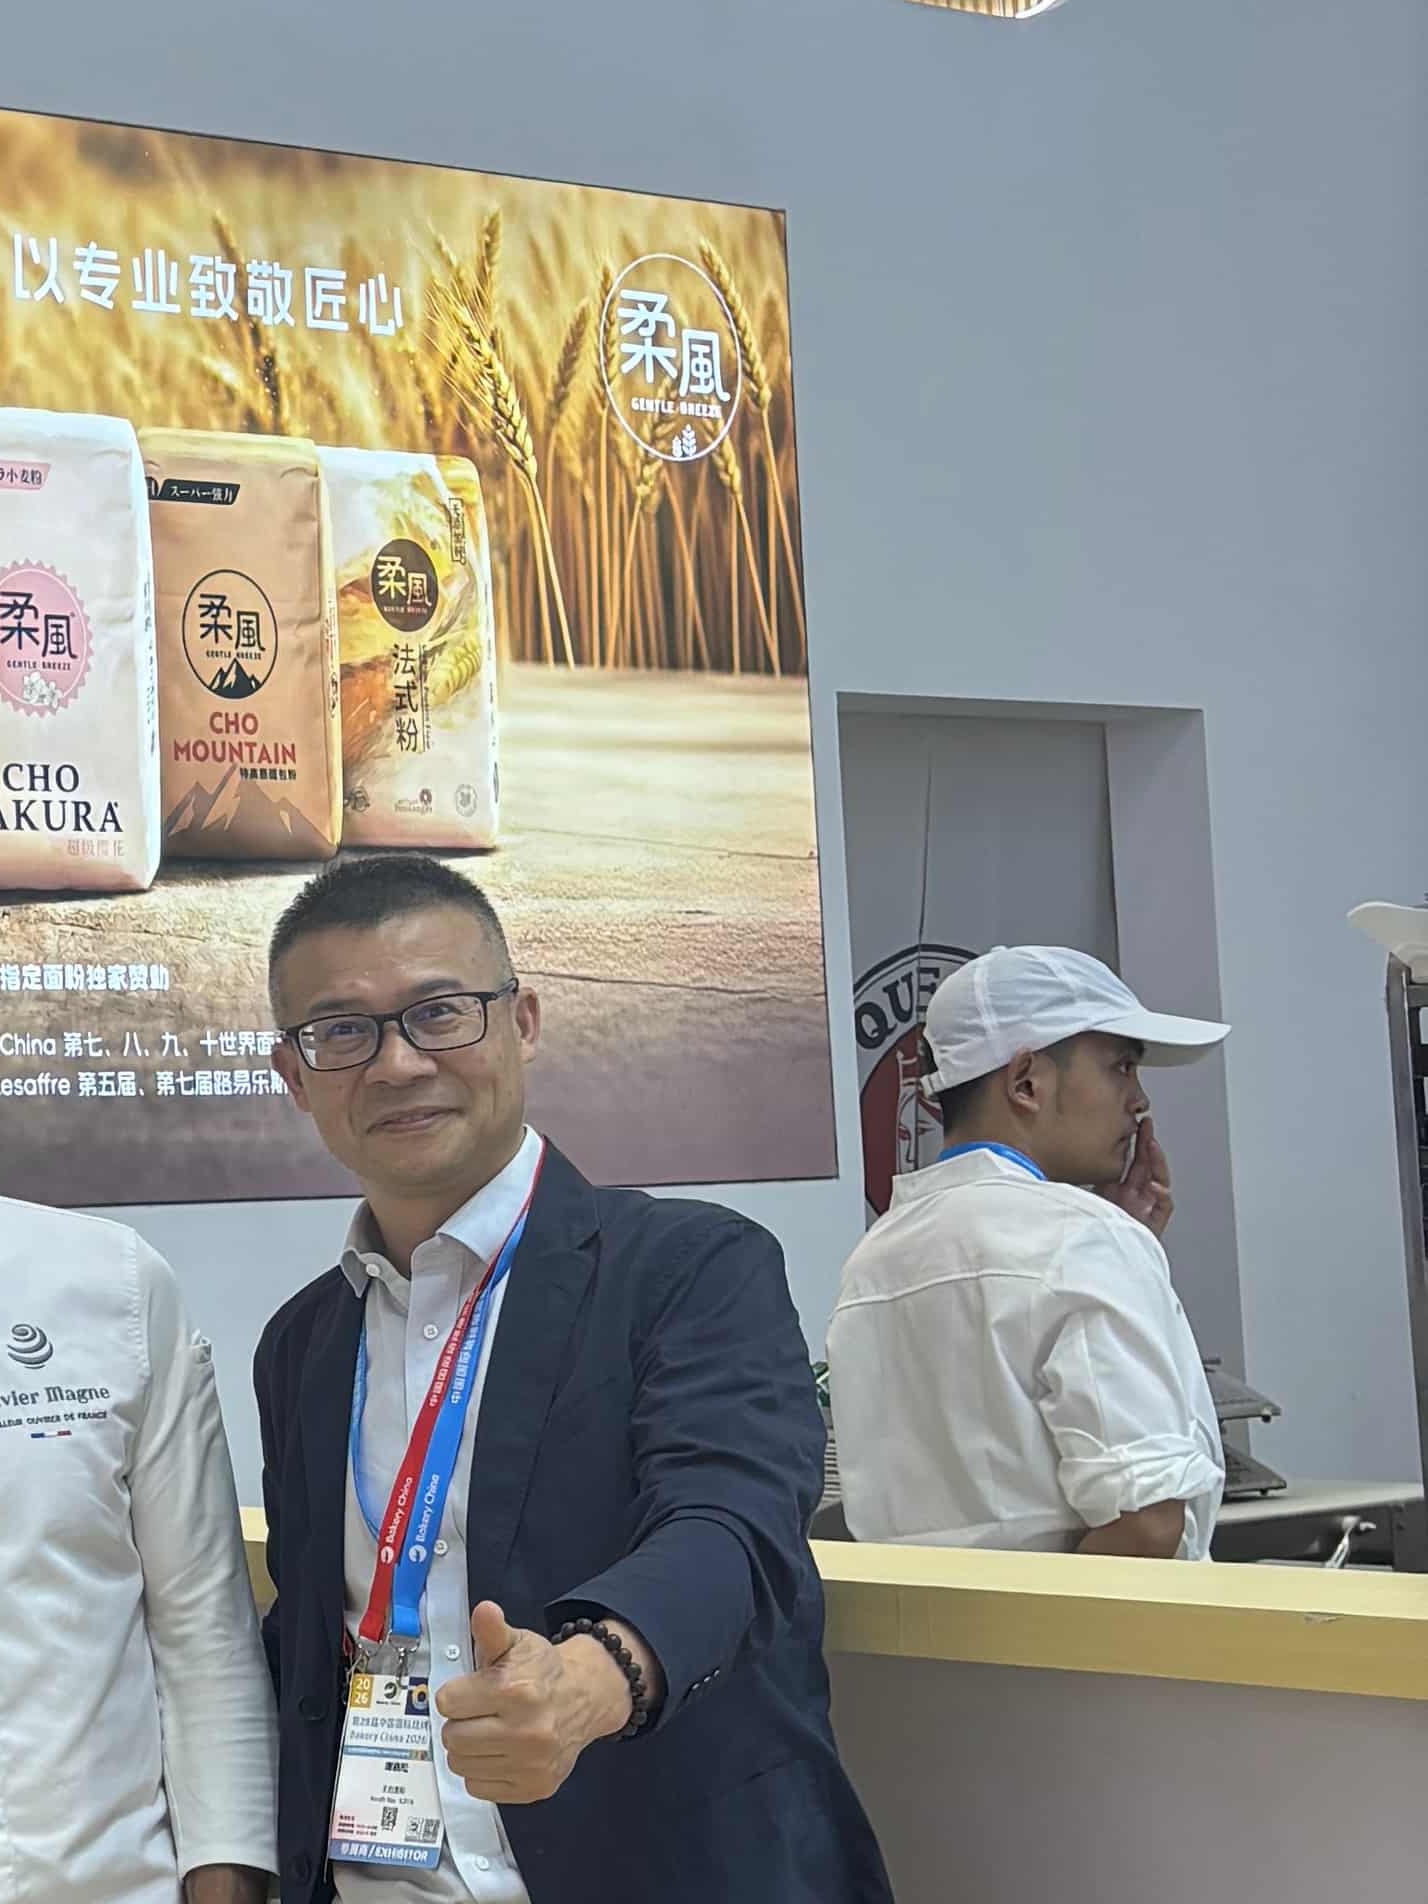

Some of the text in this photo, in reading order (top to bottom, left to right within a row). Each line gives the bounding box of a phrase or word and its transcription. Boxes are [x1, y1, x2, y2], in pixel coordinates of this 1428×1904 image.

[617, 289, 732, 402] 柔風
[376, 555, 432, 607] 柔風
[198, 593, 265, 652] 柔風
[392, 643, 420, 753] 法式粉
[208, 711, 259, 735] CHO
[172, 738, 297, 765] MOUNTAIN
[1, 762, 80, 793] CHO
[0, 1032, 57, 1058] China
[44, 1385, 111, 1404] Magne
[384, 1476, 413, 1544] Bakery China
[414, 1473, 441, 1544] Bakery China
[354, 1692, 369, 1704] 26
[355, 1678, 370, 1690] 20
[374, 1847, 429, 1862] EXHIBITOR
